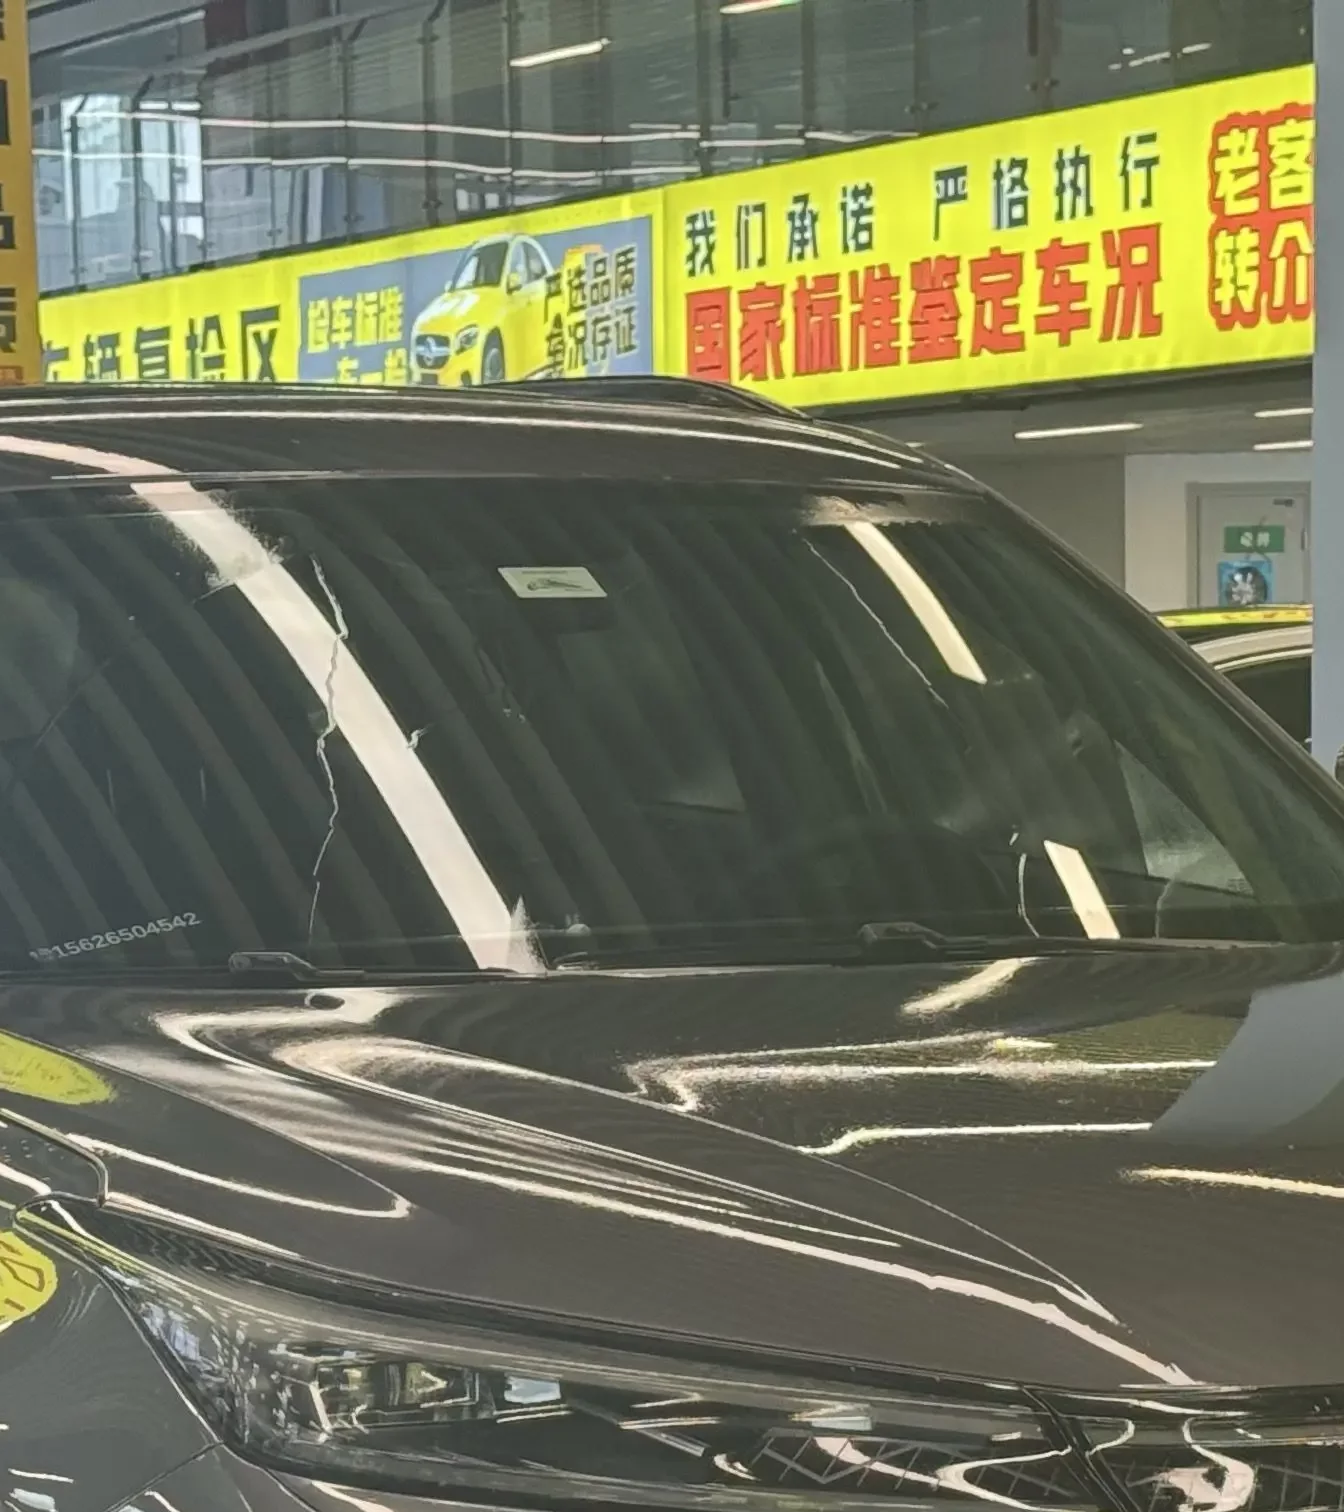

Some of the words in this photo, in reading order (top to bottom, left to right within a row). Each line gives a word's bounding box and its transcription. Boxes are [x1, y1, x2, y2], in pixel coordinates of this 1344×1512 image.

[685, 182, 875, 278] 我们承诺
[933, 131, 1161, 240] 严格执行
[542, 244, 637, 325] 严选品质
[685, 222, 1162, 384] 国家标准鉴定车况
